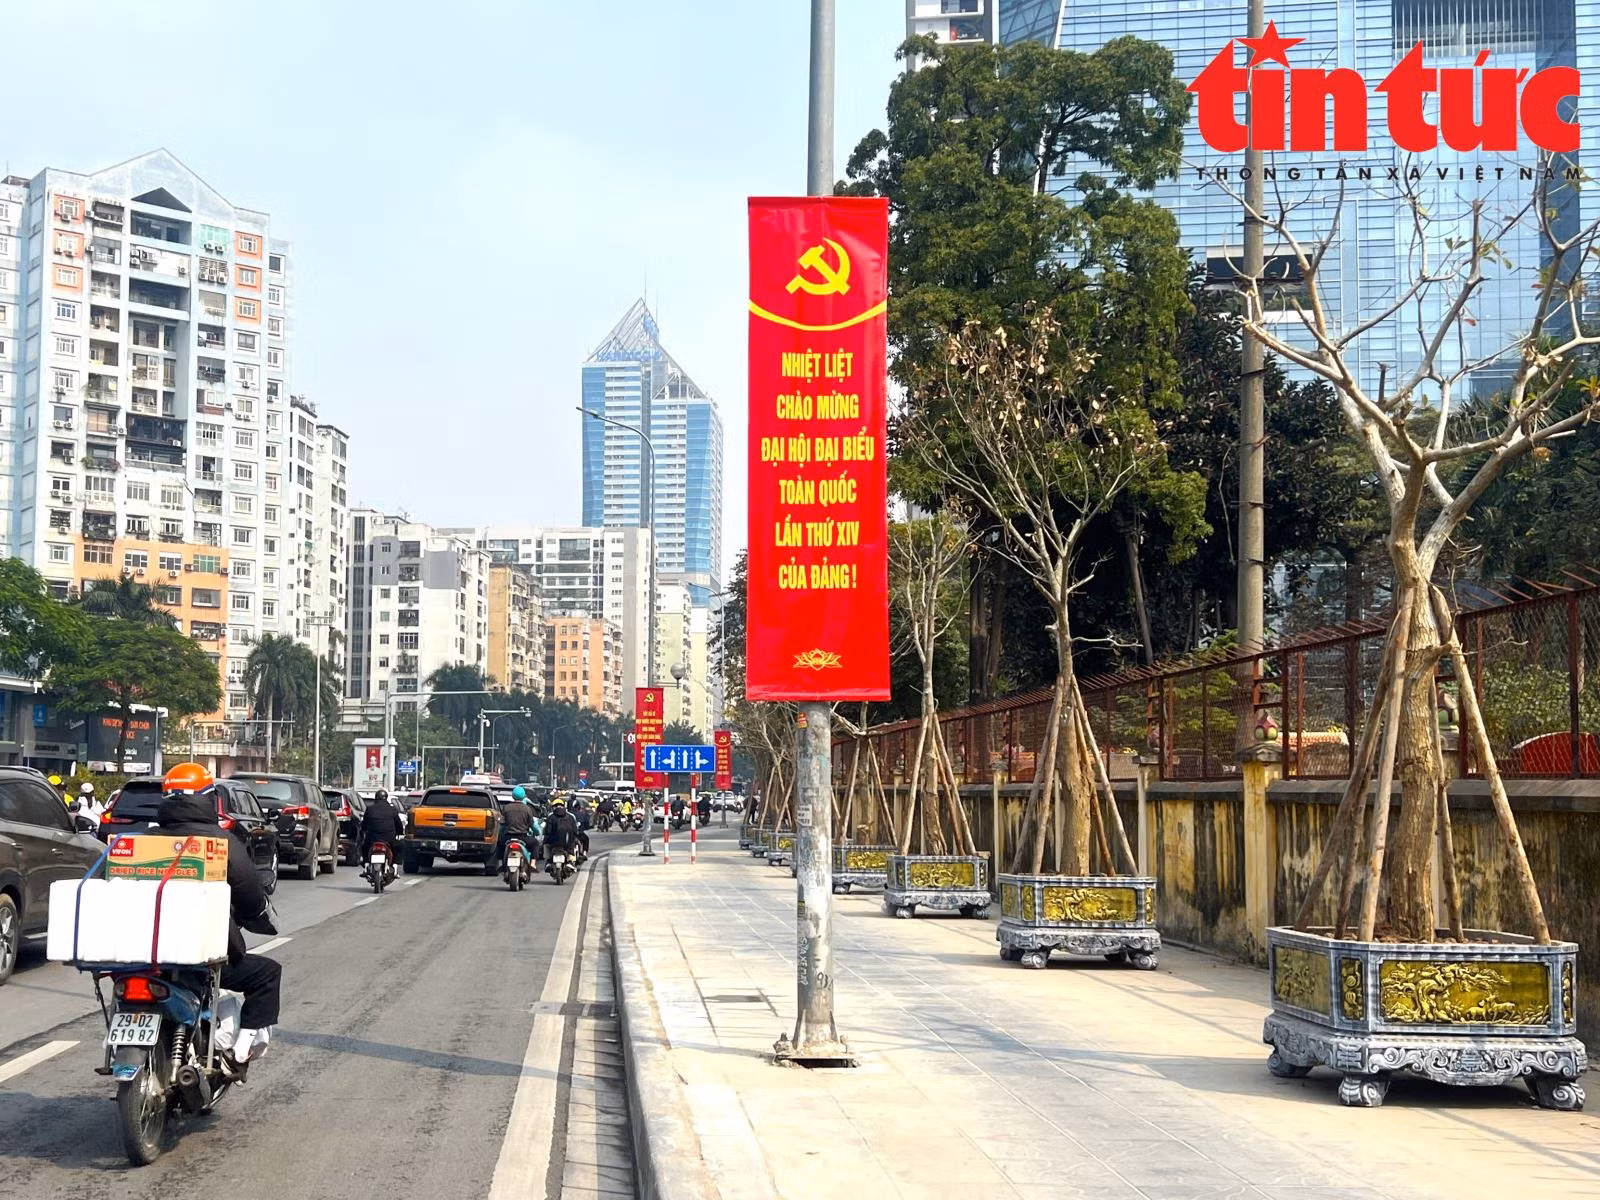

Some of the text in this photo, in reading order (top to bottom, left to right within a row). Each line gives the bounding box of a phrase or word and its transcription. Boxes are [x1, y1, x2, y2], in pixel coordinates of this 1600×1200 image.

[782, 348, 853, 383] NHIỆT LIỆT
[776, 390, 859, 420] CHÀO MỪNG
[761, 426, 875, 468] ĐẠI HỘI ĐẠI BIỂU
[779, 470, 857, 507] TOÀN QUỐC
[775, 513, 860, 547] LẦN THỨ XIV
[778, 556, 807, 589] CỦA
[109, 866, 198, 876] DRIED RICE NDLES
[117, 1014, 132, 1028] 29
